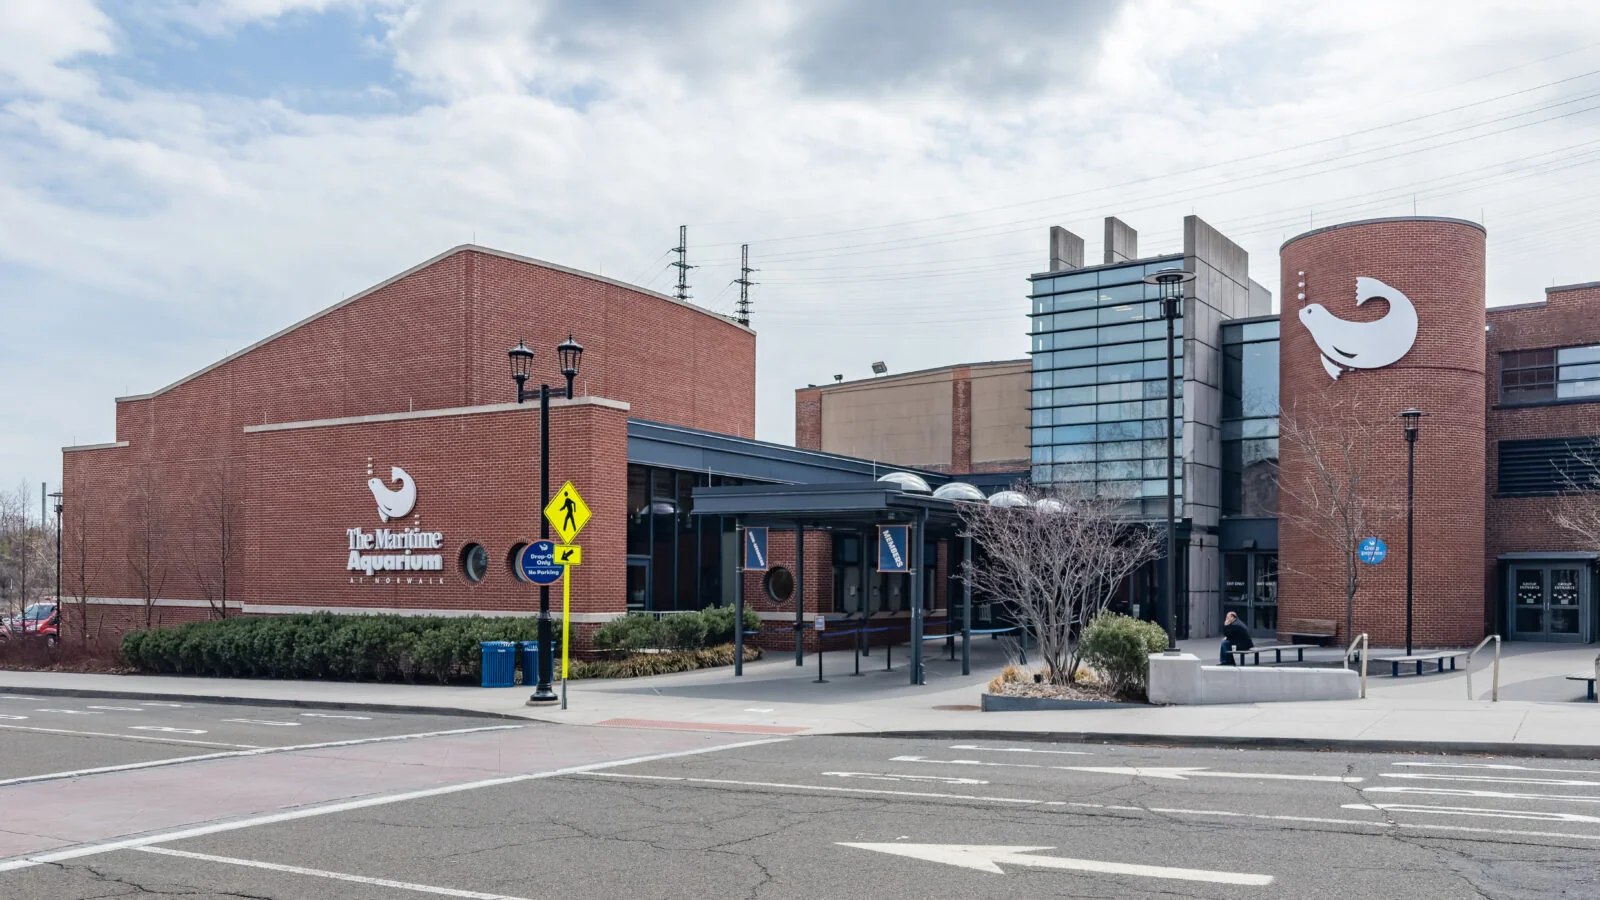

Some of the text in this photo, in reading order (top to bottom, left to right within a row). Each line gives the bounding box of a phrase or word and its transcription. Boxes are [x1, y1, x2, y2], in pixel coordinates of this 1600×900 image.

[346, 527, 443, 550] The Maritime
[883, 529, 903, 567] MEMBERS
[346, 549, 443, 576] Aquarium
[349, 577, 444, 585] AT NORWALK
